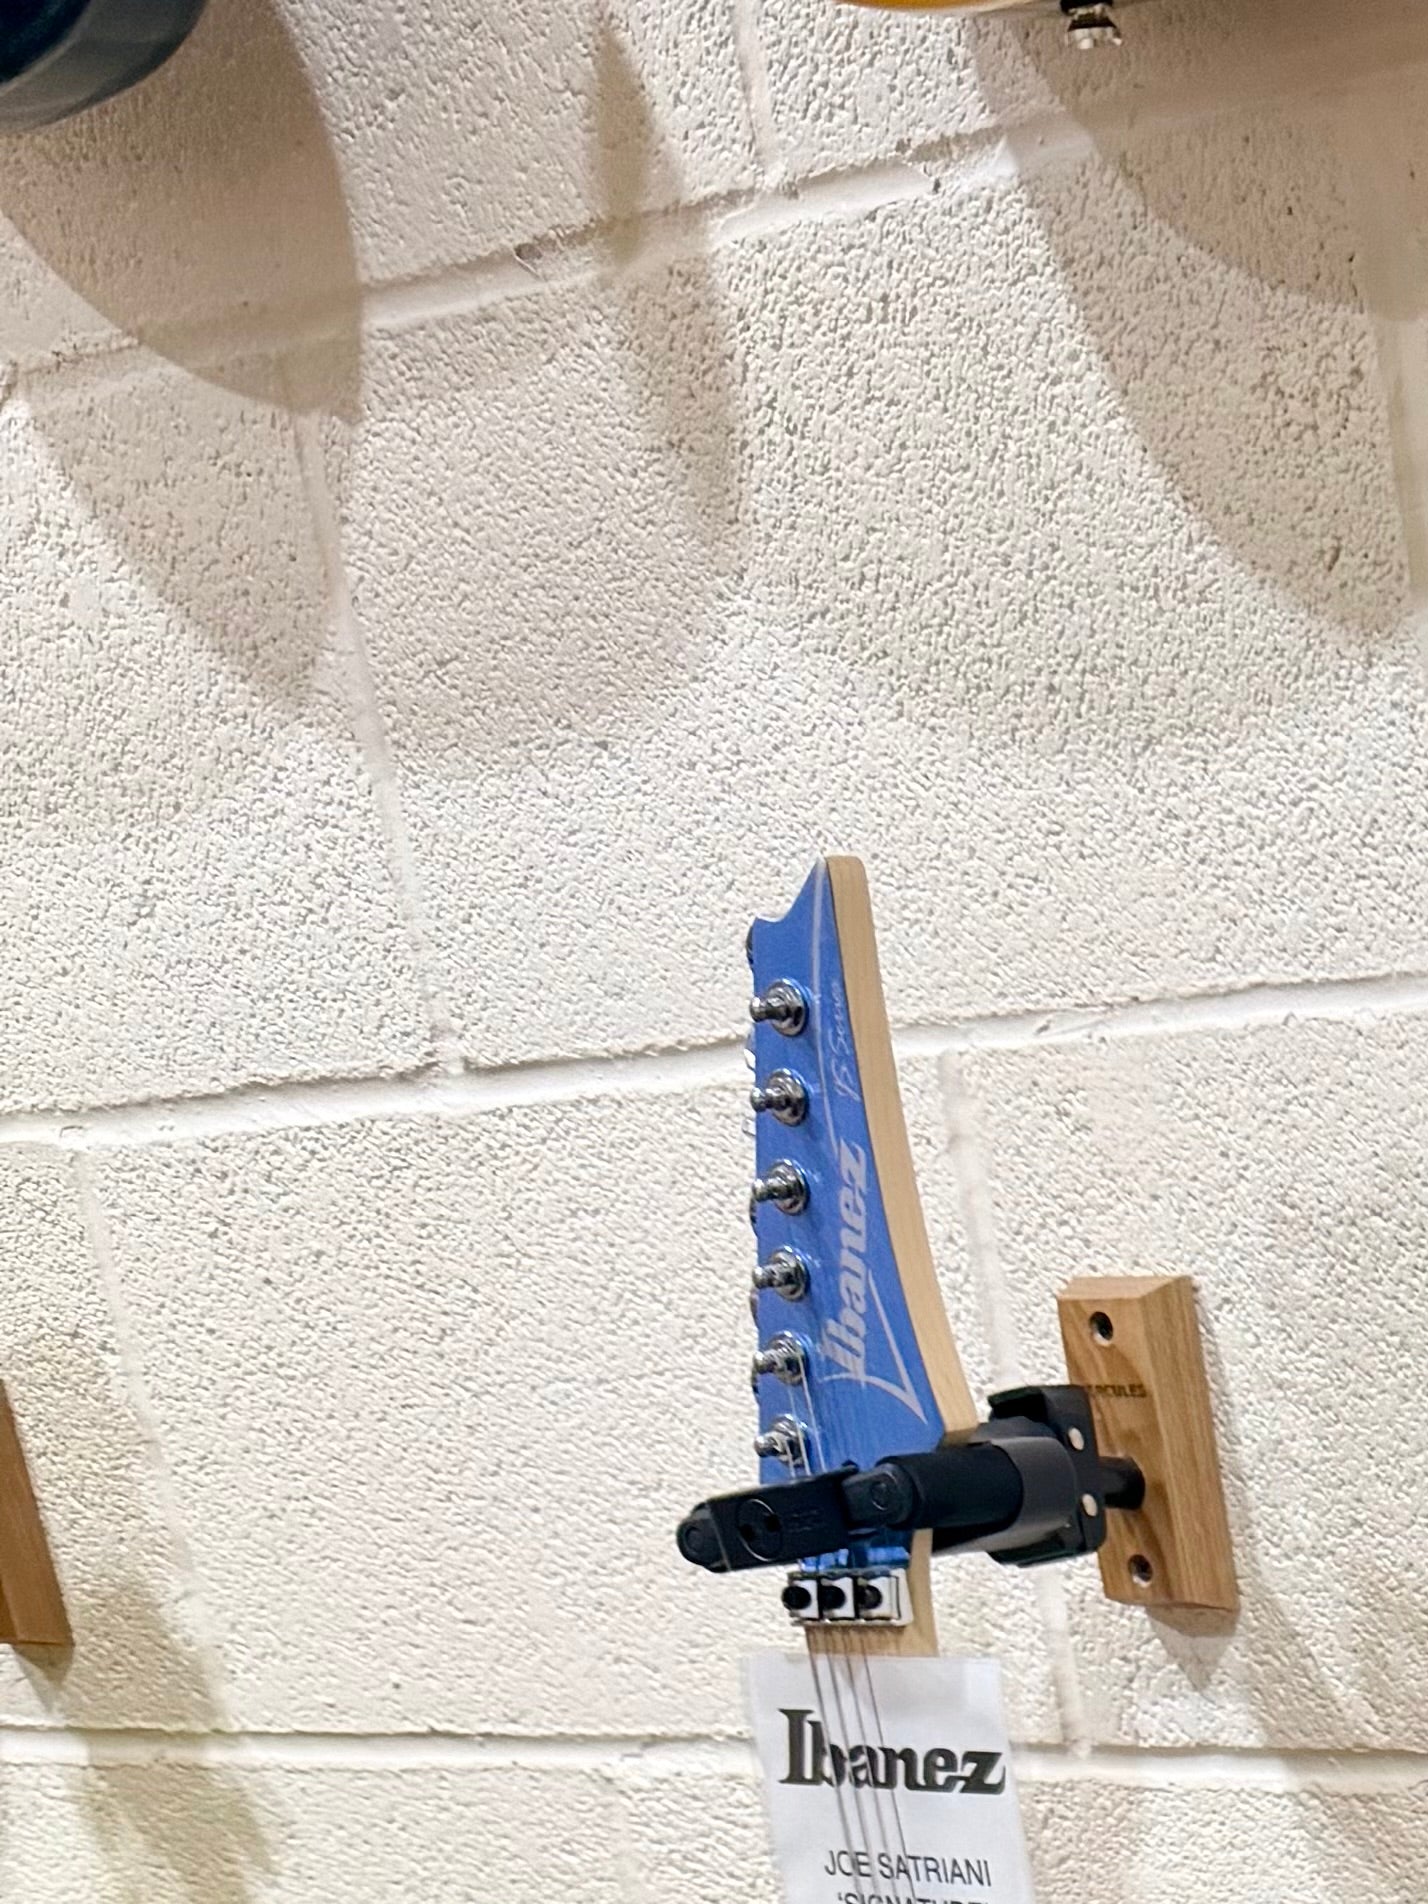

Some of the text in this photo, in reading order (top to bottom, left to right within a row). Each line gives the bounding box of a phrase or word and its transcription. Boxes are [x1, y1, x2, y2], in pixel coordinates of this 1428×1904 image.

[821, 1137, 867, 1388] Ibanez
[777, 1708, 1006, 1796] Ibanez
[825, 1850, 992, 1887] JOE SATRIANI
